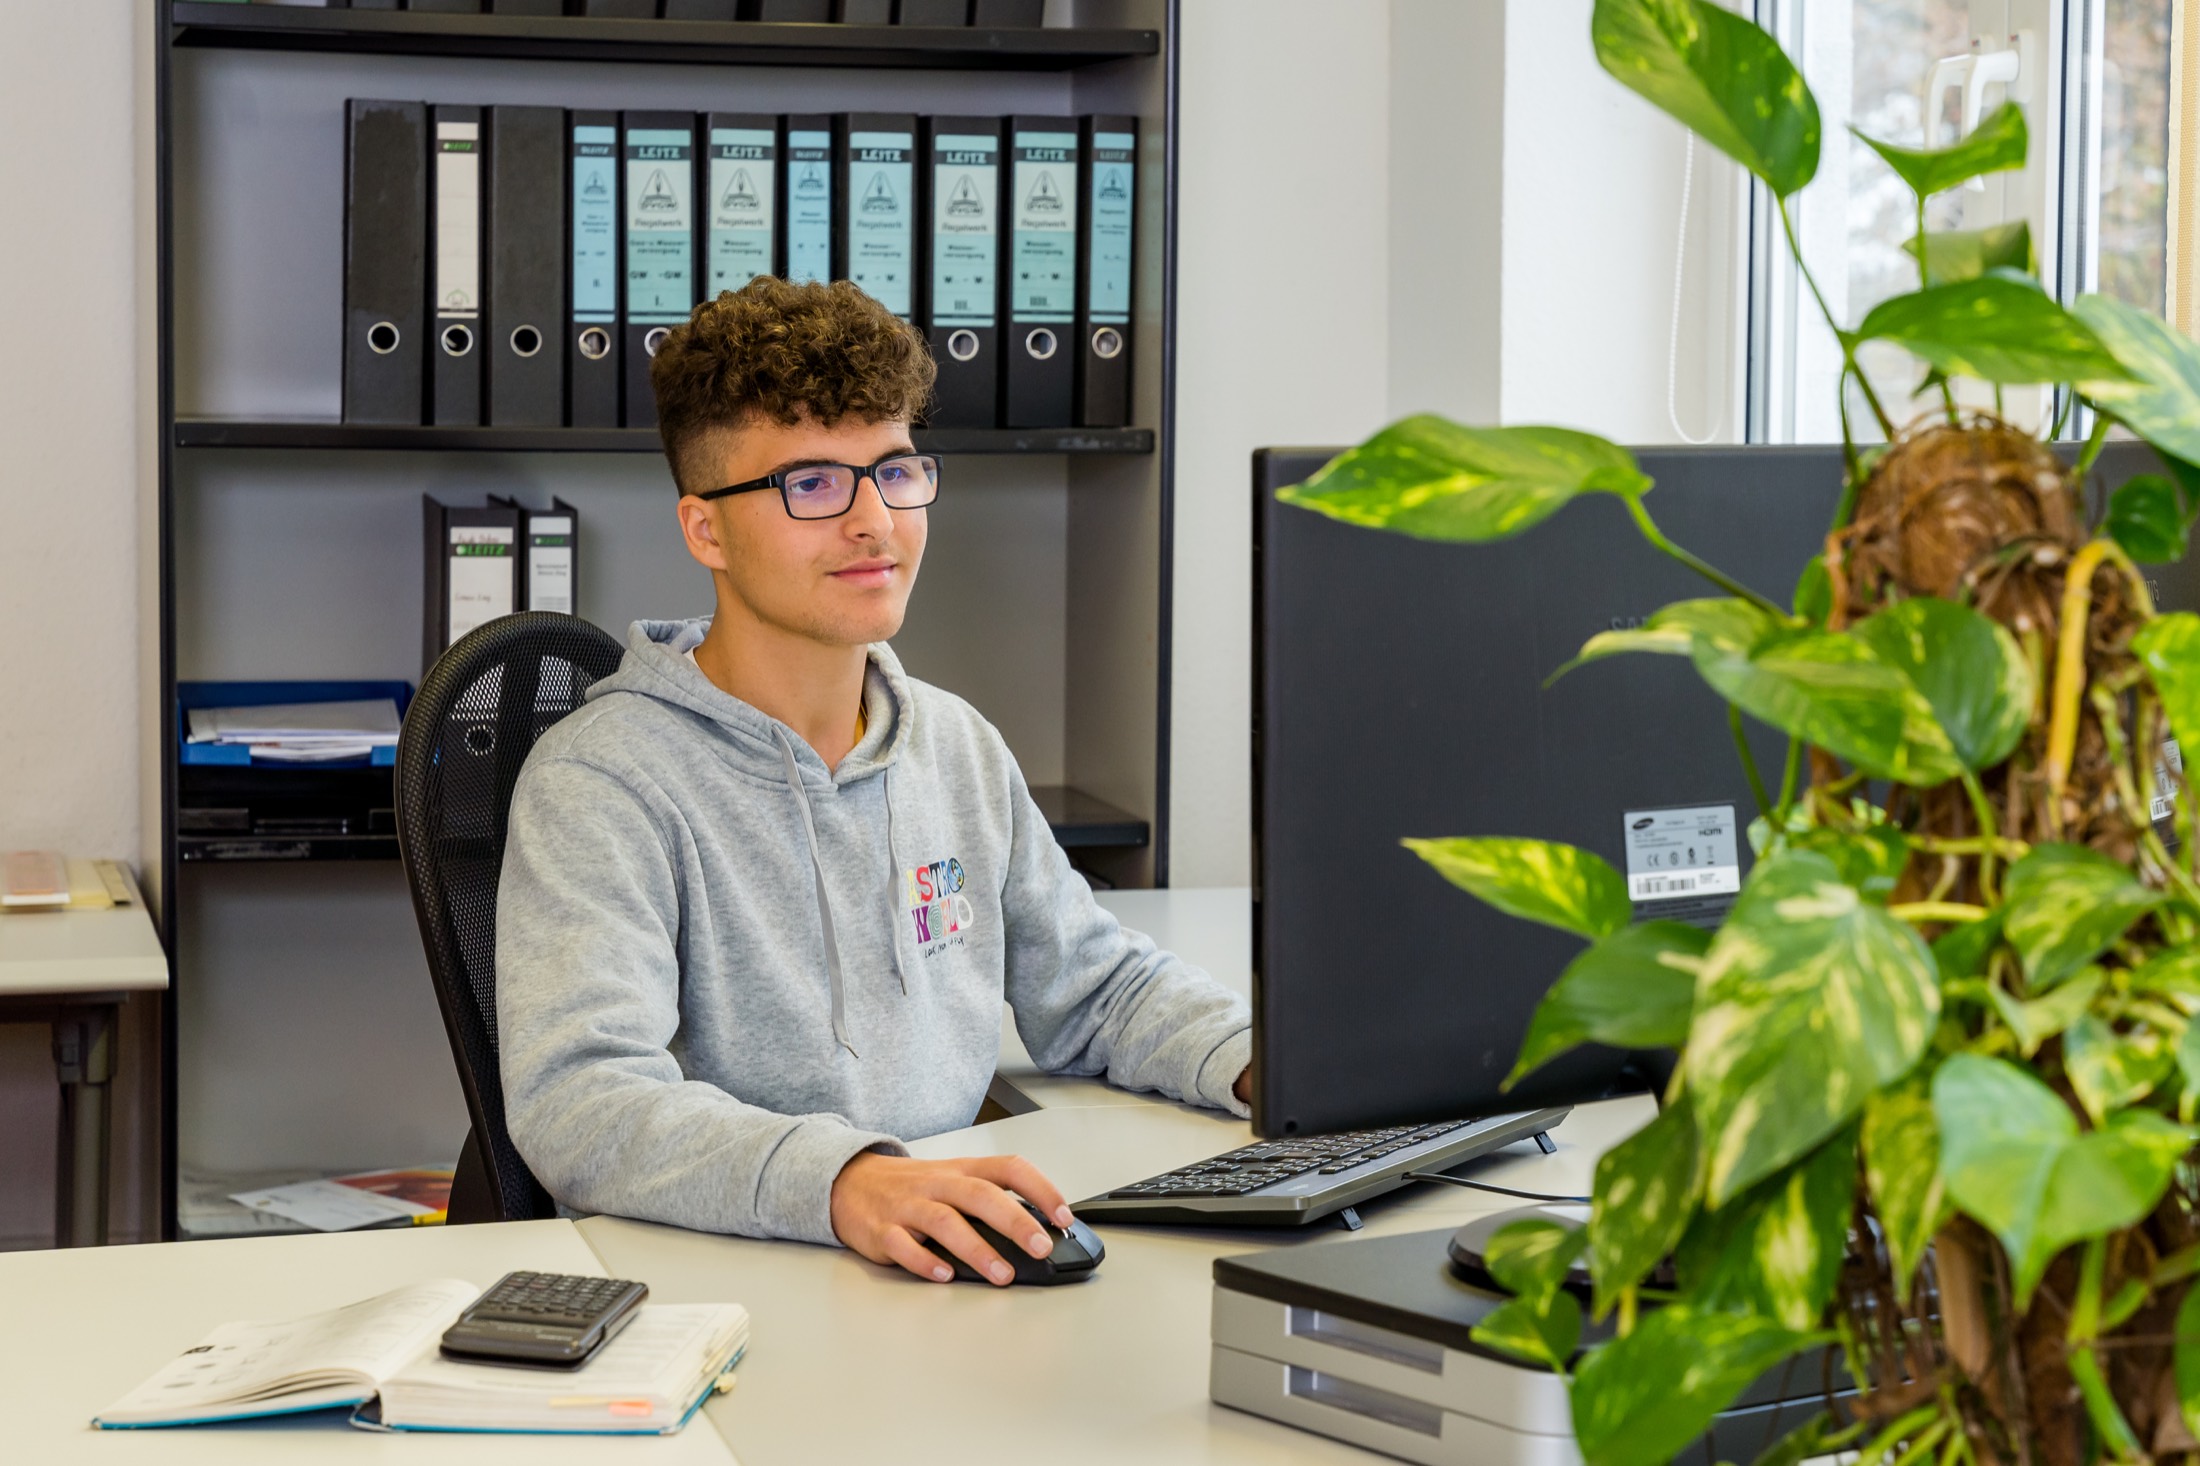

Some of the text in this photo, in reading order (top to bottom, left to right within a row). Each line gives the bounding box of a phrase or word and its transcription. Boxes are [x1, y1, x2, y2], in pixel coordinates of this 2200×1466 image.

[638, 146, 681, 160] LEITZ
[721, 145, 764, 159] LEITZ
[860, 149, 903, 162] LEITZ
[946, 152, 988, 164] LEITZ
[1025, 149, 1067, 161] LEITZ
[467, 544, 506, 556] LEITZ
[906, 857, 965, 908] ASTRO
[911, 894, 974, 945] WORLD
